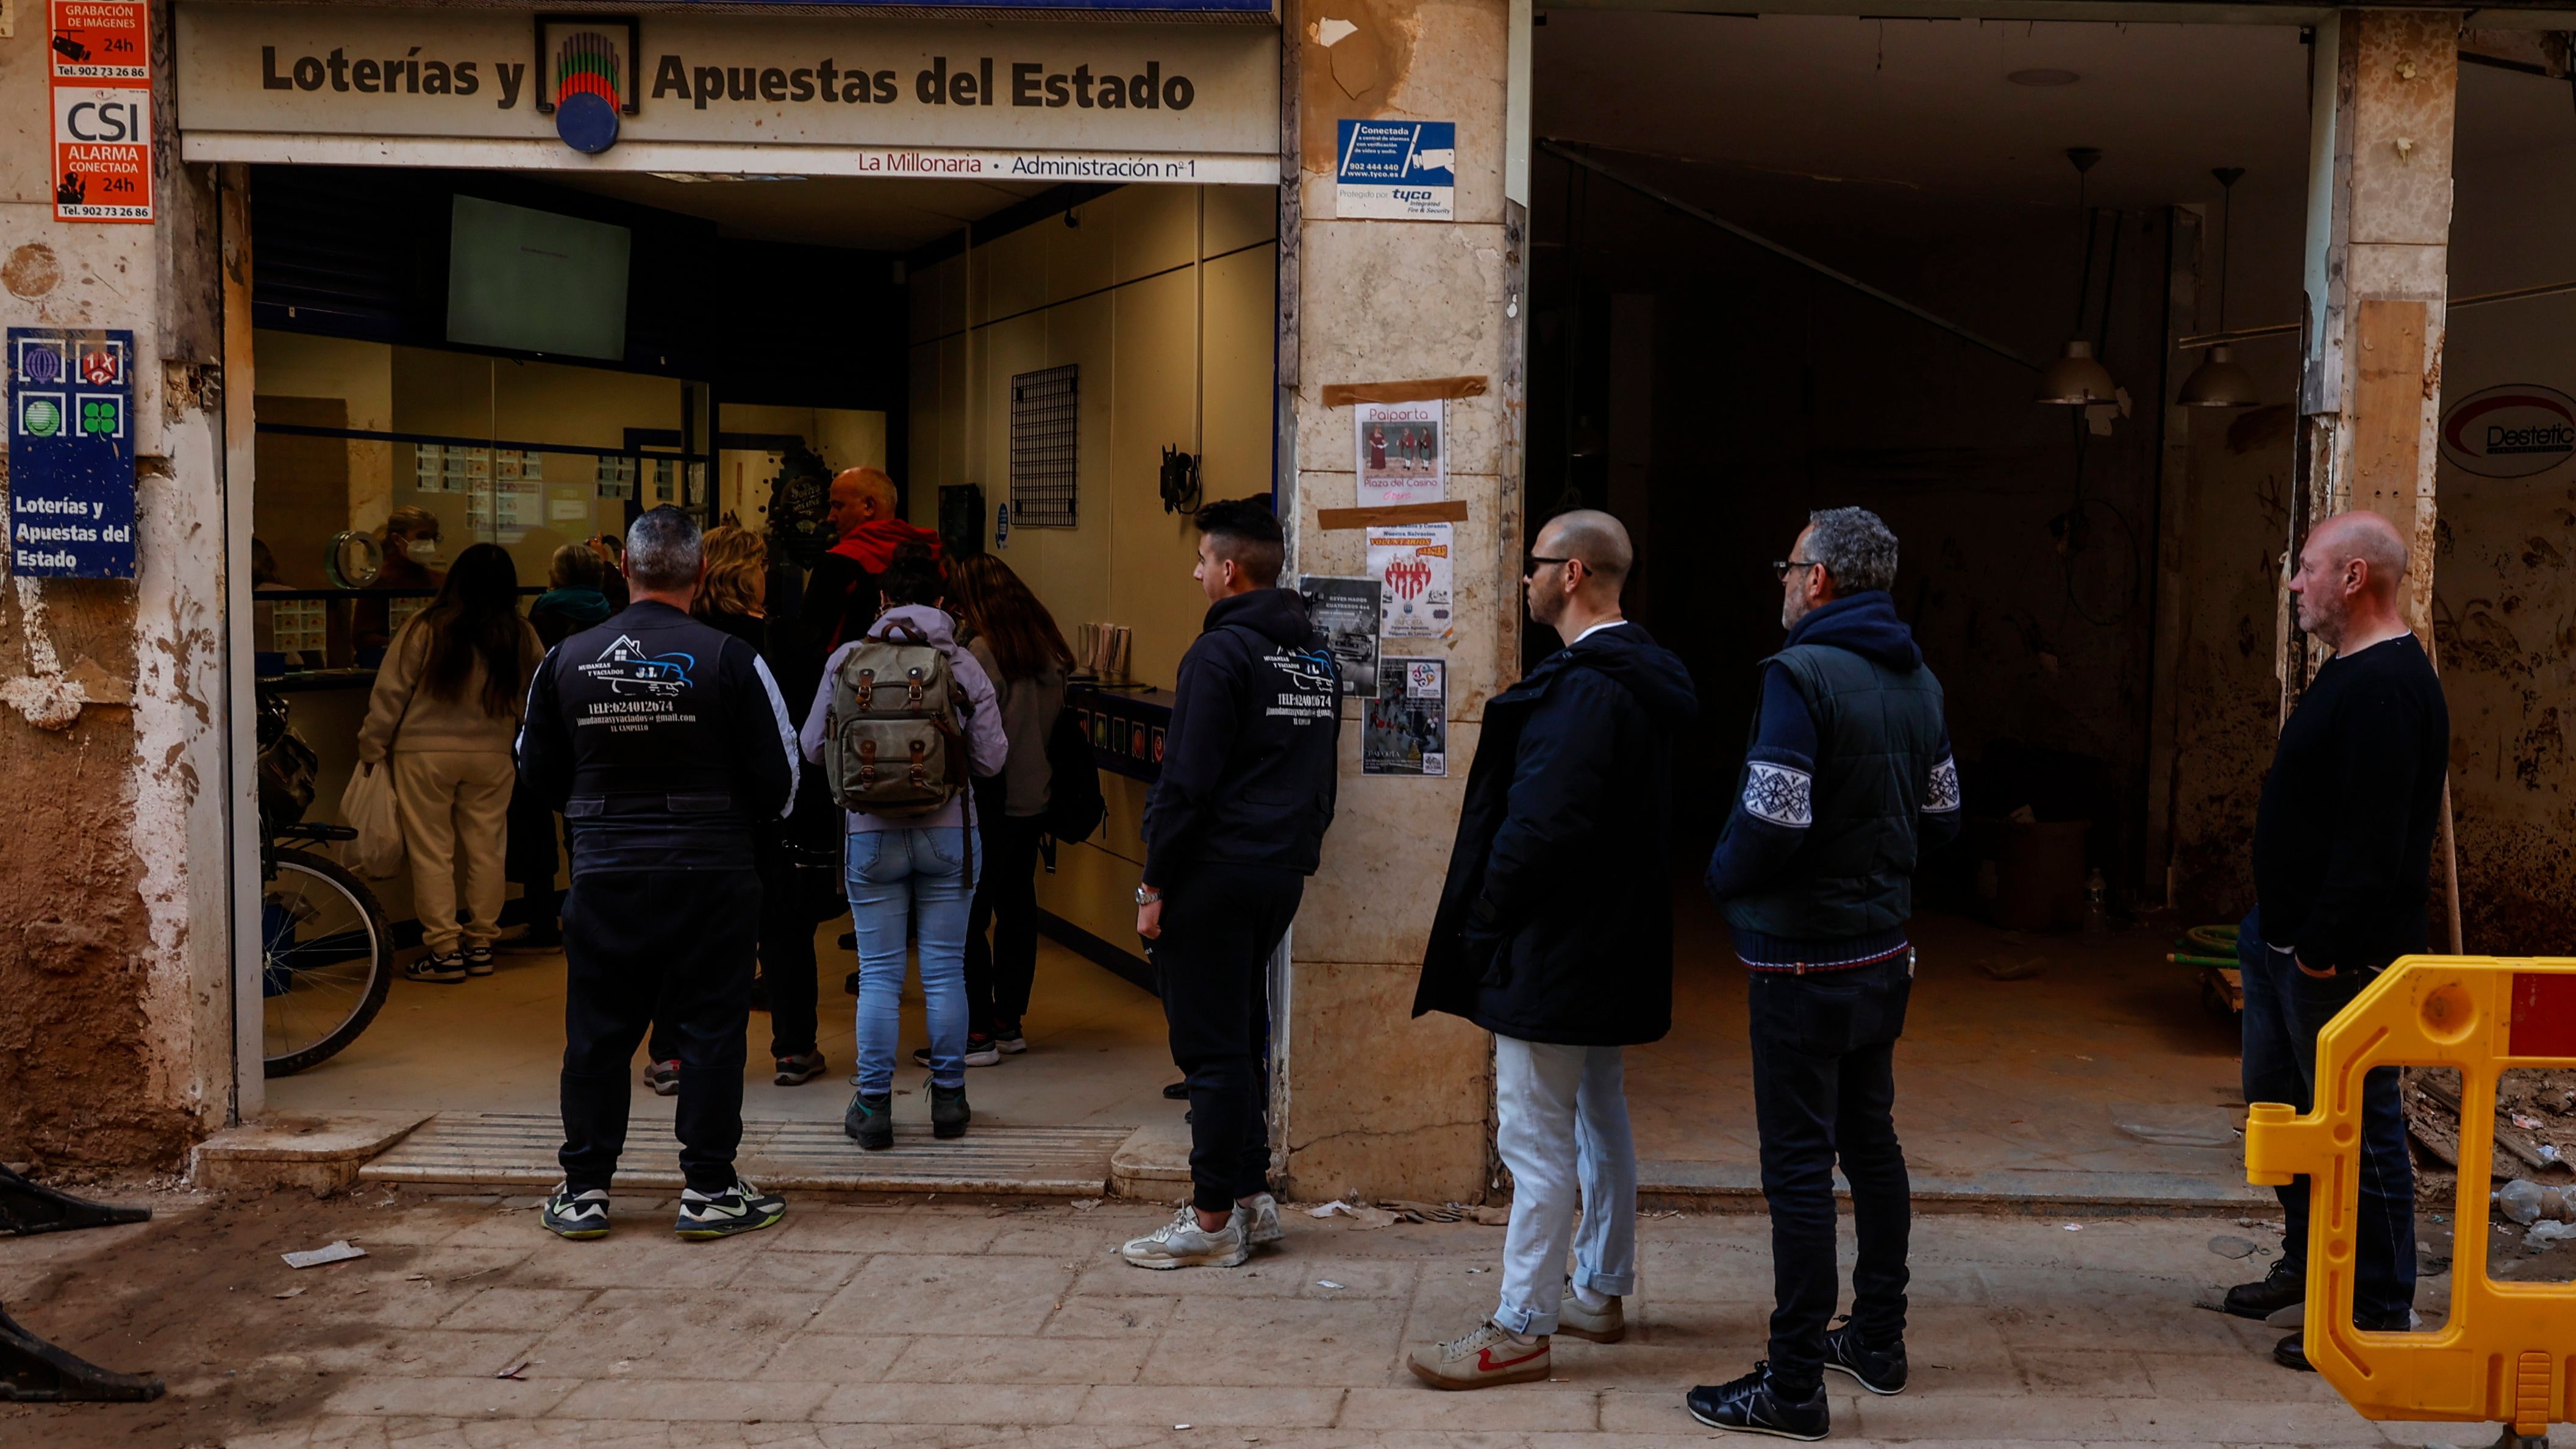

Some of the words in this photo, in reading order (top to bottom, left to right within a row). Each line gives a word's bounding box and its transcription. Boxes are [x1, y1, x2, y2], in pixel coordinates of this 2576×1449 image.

[65, 4, 134, 16] GRABACIÓN
[68, 17, 81, 27] DE
[84, 17, 135, 28] IMÁGENES
[104, 38, 134, 52] 24h
[58, 66, 76, 75] Tel.
[78, 66, 98, 76] 902
[101, 67, 113, 77] 73
[116, 68, 129, 77] 26
[131, 68, 144, 77] 86
[262, 46, 479, 95] Loterías
[495, 63, 525, 110] y
[651, 55, 898, 110] Apuestas
[915, 56, 993, 106] del
[1012, 61, 1195, 110] Estado
[68, 101, 138, 142] CSI
[1361, 126, 1408, 135] Conectada
[68, 146, 139, 161] ALARMA
[69, 162, 139, 173] CONECTADA
[858, 152, 880, 171] La
[887, 153, 982, 173] Millonaria
[1011, 156, 1159, 177] Administración
[103, 177, 134, 192] 24h
[1340, 190, 1374, 198] Protegido
[1392, 188, 1432, 202] tyco
[63, 206, 80, 215] Tel.
[82, 207, 102, 216] 902
[104, 207, 116, 216] 73
[120, 208, 133, 216] 26
[135, 209, 148, 217] 86
[1369, 407, 1428, 423] Paiporta
[1363, 478, 1389, 487] Plaza
[1390, 478, 1404, 487] del
[1406, 478, 1438, 487] Casino
[16, 496, 88, 514] Loterías
[92, 502, 104, 520] y
[16, 523, 98, 545] Apuestas
[102, 524, 130, 543] del
[16, 549, 77, 568] Estado
